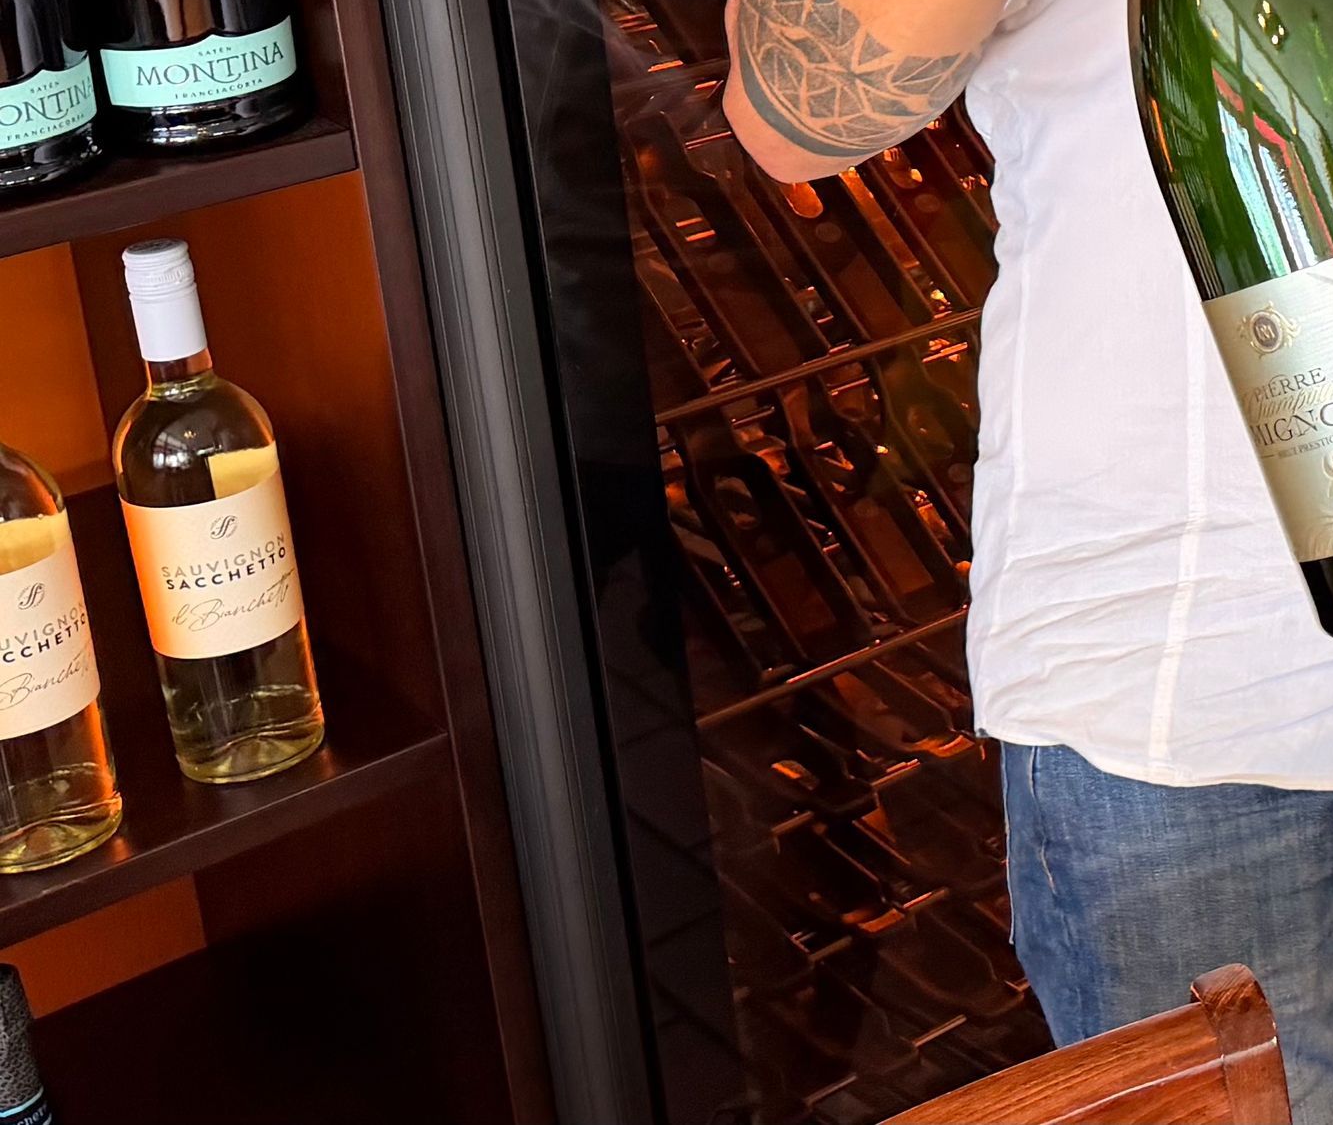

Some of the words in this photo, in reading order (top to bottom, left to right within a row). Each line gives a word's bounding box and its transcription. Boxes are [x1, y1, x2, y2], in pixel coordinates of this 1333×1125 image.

[136, 41, 284, 85] MONTINA
[0, 76, 93, 126] ONTINA
[175, 78, 263, 99] FRANCIACORTA
[1254, 367, 1326, 402] PIERRE
[161, 531, 285, 577] SAUVIGNON
[166, 546, 286, 589] SACCHETTO
[2, 613, 86, 663] CCHETTO
